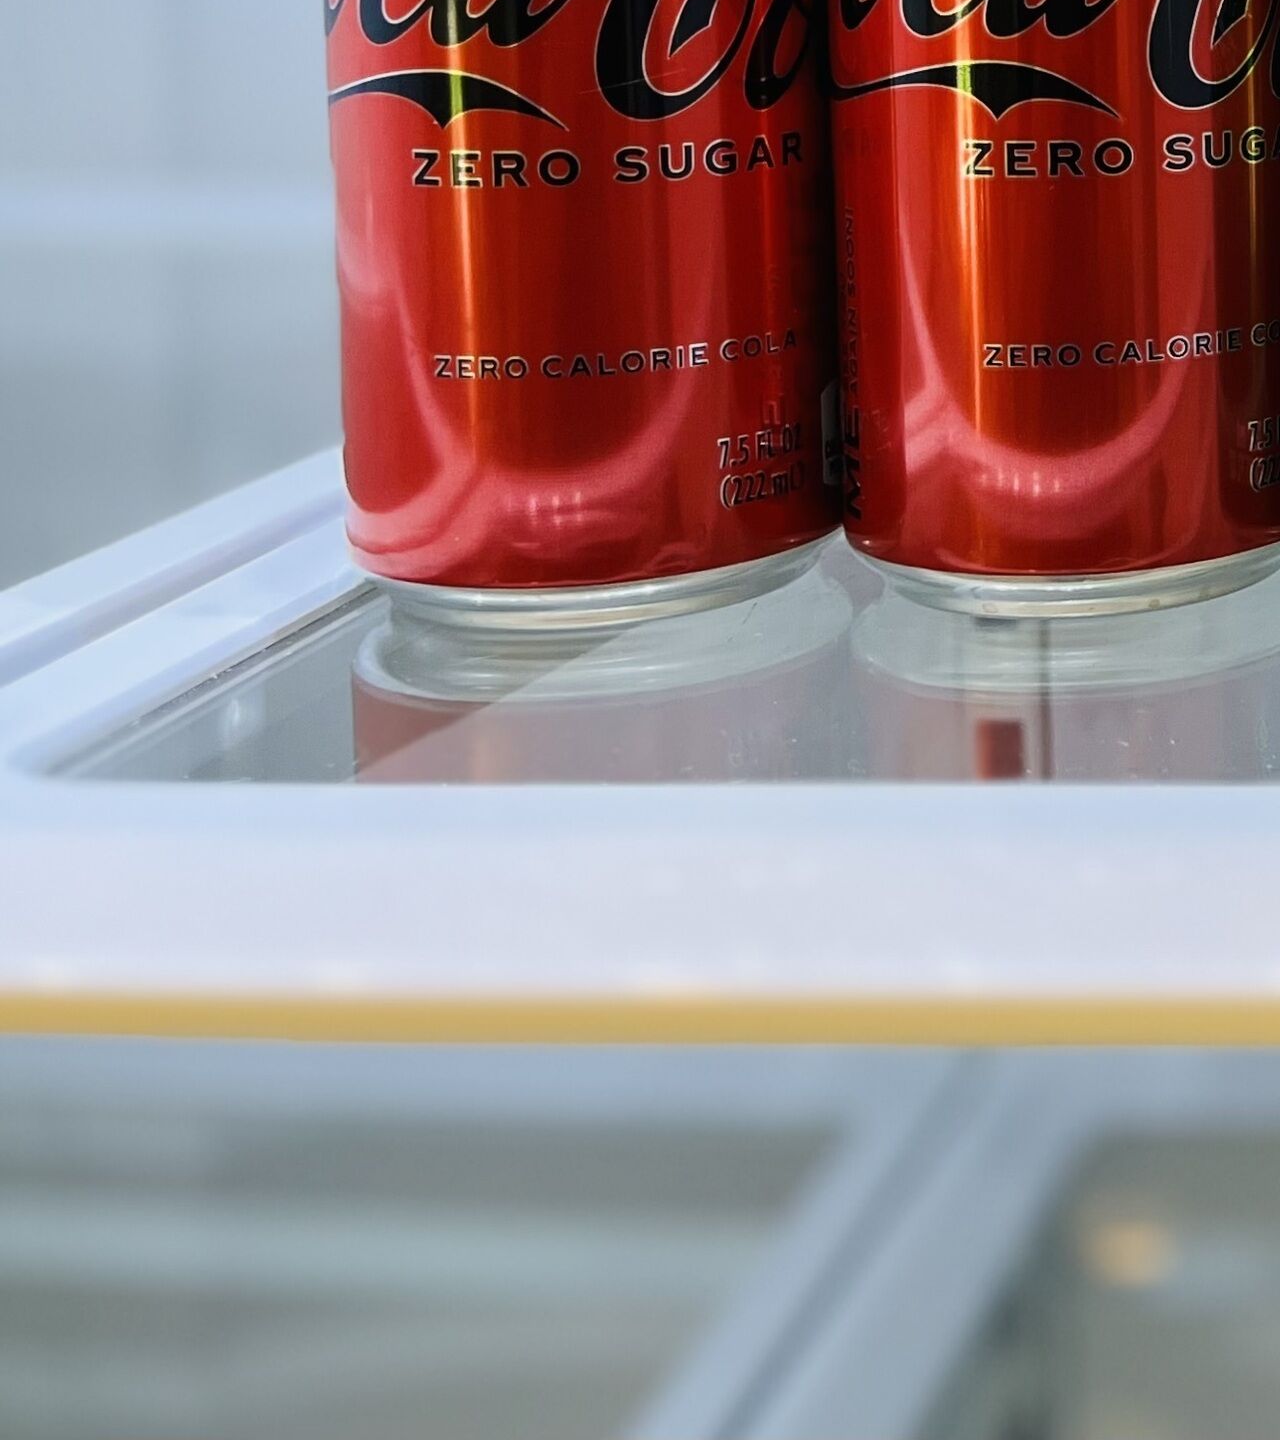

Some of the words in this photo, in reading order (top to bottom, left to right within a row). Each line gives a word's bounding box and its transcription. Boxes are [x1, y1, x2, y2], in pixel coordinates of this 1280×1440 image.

[411, 148, 581, 189] ZERO
[613, 131, 803, 184] SUGAR
[964, 138, 1135, 178] ZERO
[434, 354, 528, 381] ZERO
[540, 342, 709, 379] CALORIE
[720, 329, 797, 363] COLA
[983, 343, 1081, 368] ZERO
[1092, 327, 1243, 365] CALORIE
[717, 434, 751, 469] 7.5
[755, 429, 775, 460] FL
[1248, 416, 1273, 453] 7.5
[720, 470, 767, 511] (222
